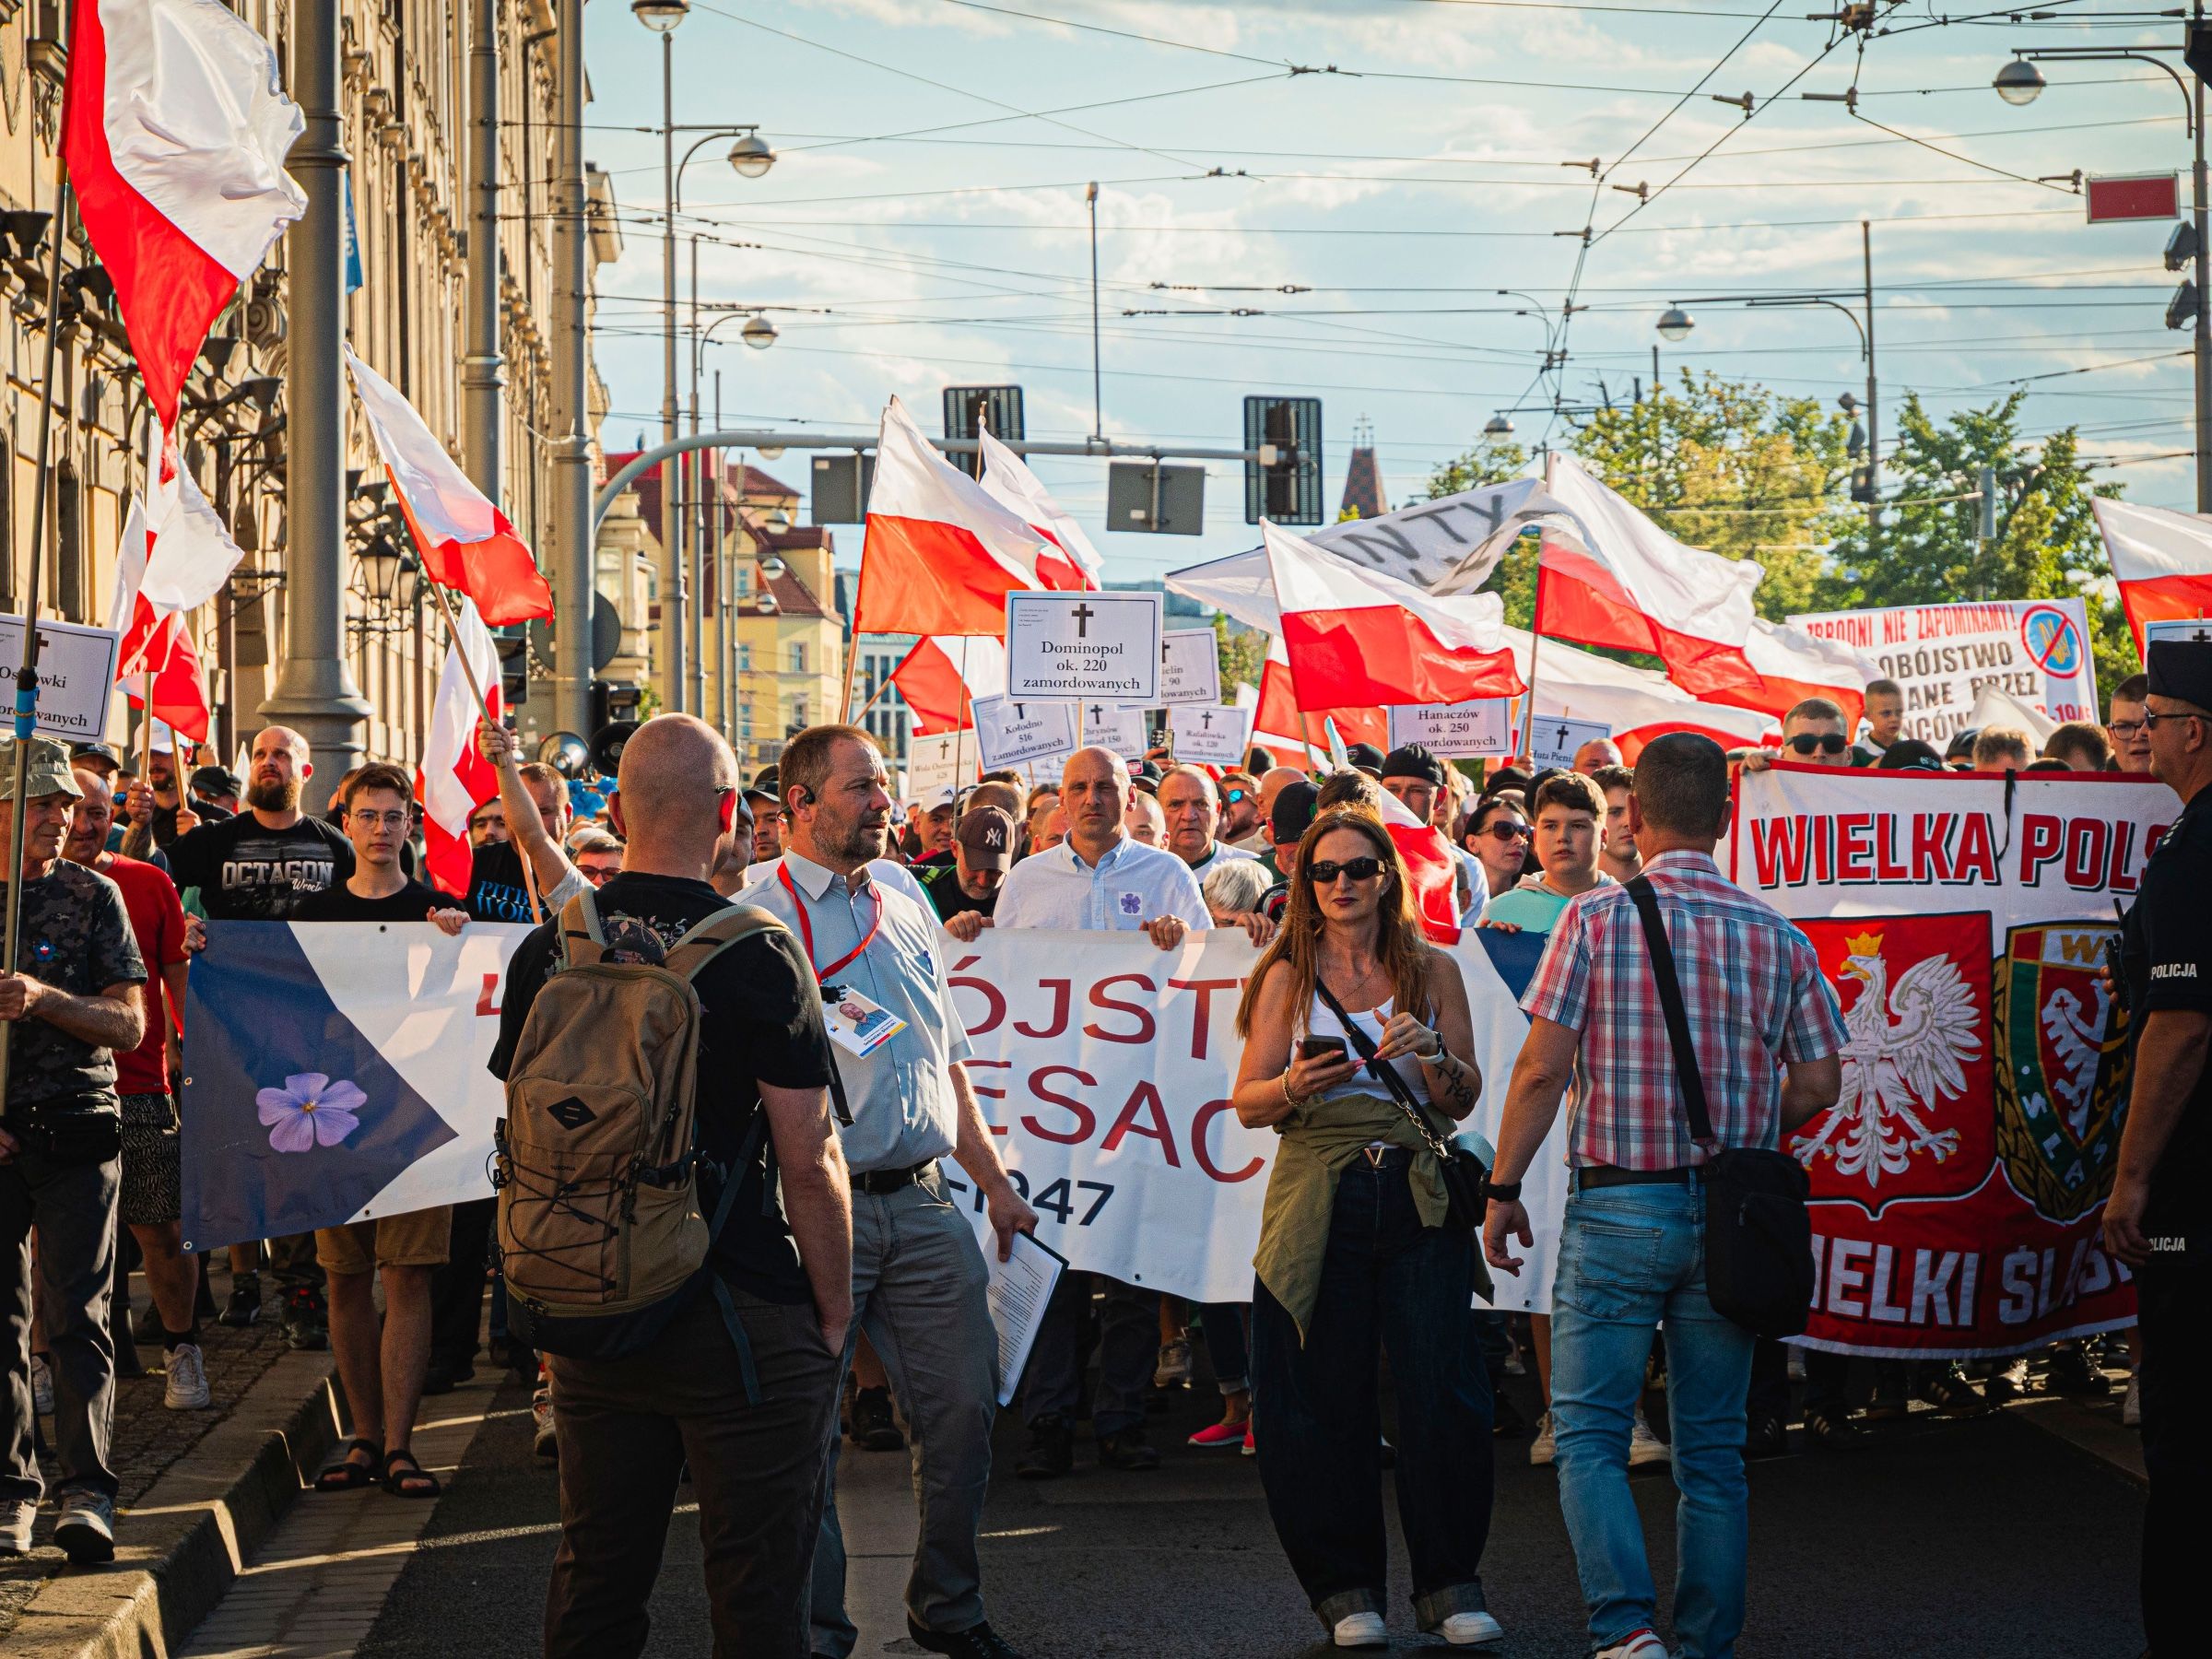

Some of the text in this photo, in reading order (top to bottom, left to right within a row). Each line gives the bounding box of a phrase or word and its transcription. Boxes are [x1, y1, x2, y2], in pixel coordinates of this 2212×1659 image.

[1884, 610, 1907, 644] NIE
[1041, 641, 1124, 658] Dominopol
[1056, 659, 1107, 671] ok. 220
[1023, 677, 1140, 692] zamordowanych
[1418, 709, 1480, 720] Hanaczów
[1005, 720, 1042, 735] Kołodno
[1429, 723, 1469, 734] ok. 250
[1018, 733, 1033, 743] 516
[992, 737, 1065, 761] zamordowanych
[1750, 812, 2002, 889] WIELKA
[222, 860, 335, 890] OCTAGON
[2150, 963, 2197, 981] POLICJA
[947, 955, 1251, 1061] ÓJST
